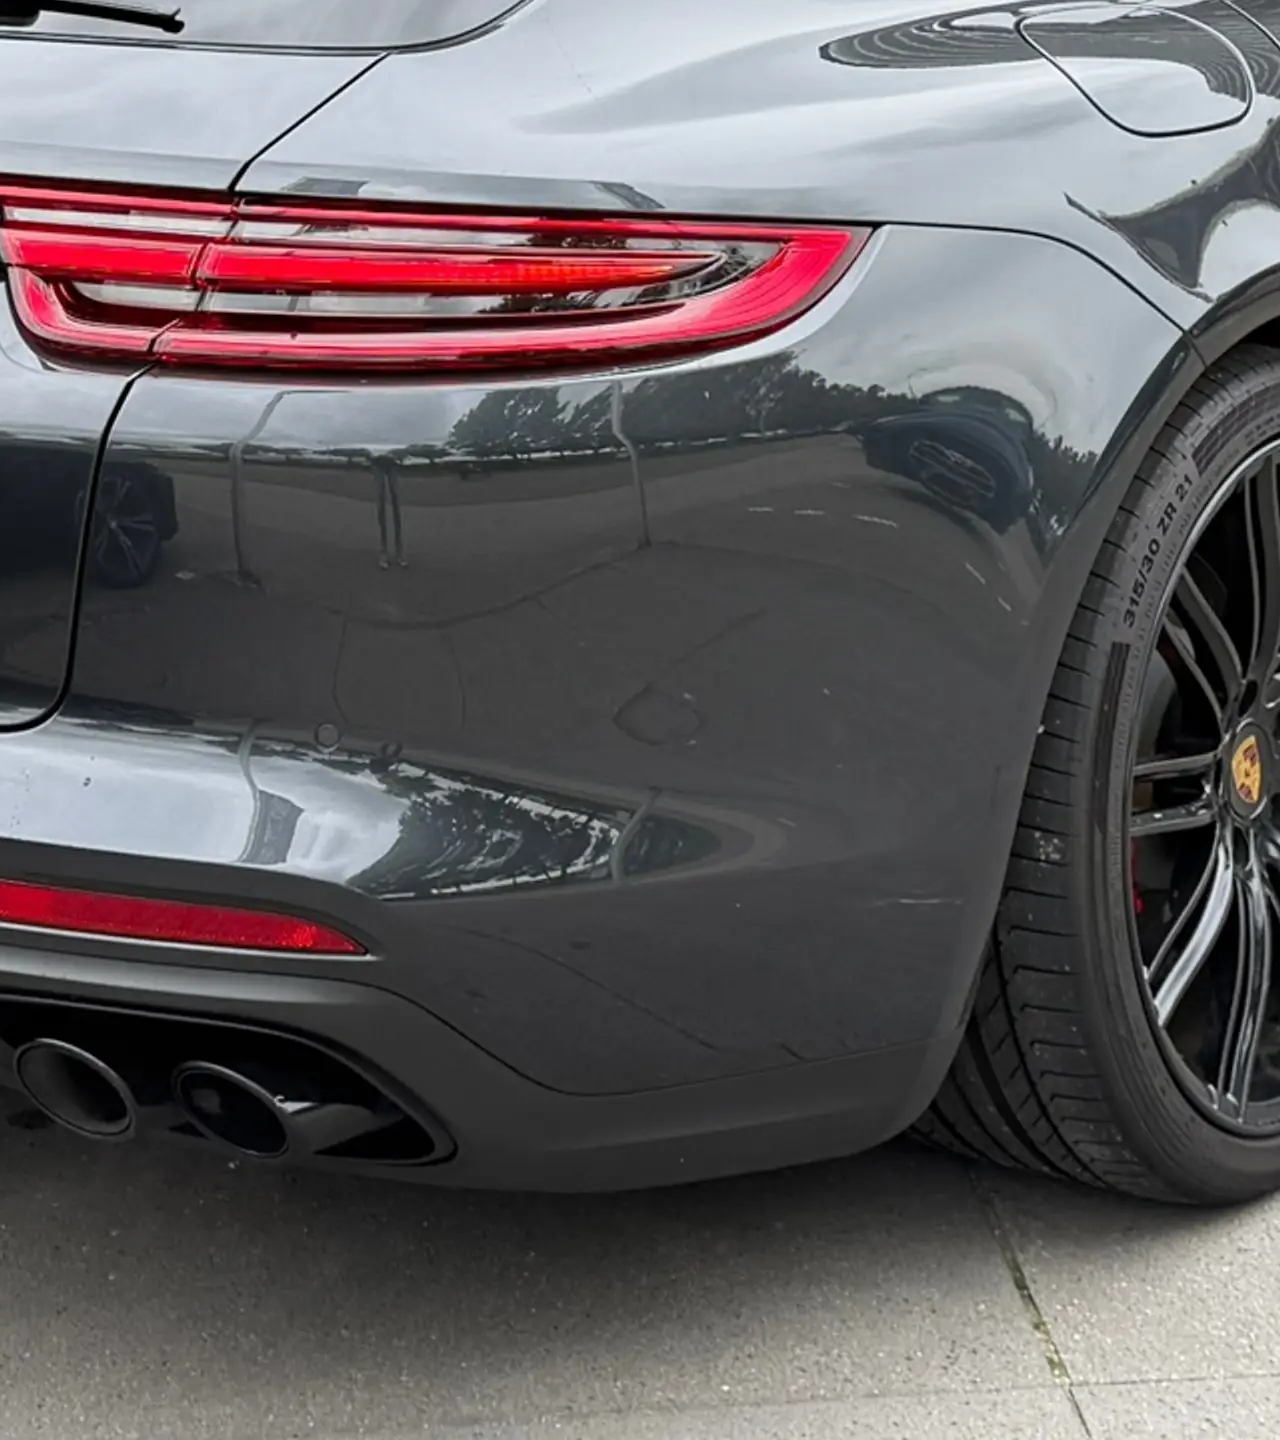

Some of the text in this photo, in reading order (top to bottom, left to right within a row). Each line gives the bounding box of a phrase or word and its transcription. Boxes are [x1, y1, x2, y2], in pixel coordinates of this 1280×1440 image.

[1123, 537, 1161, 628] 315/30
[1156, 501, 1178, 536] ZR
[1175, 473, 1193, 502] 21
